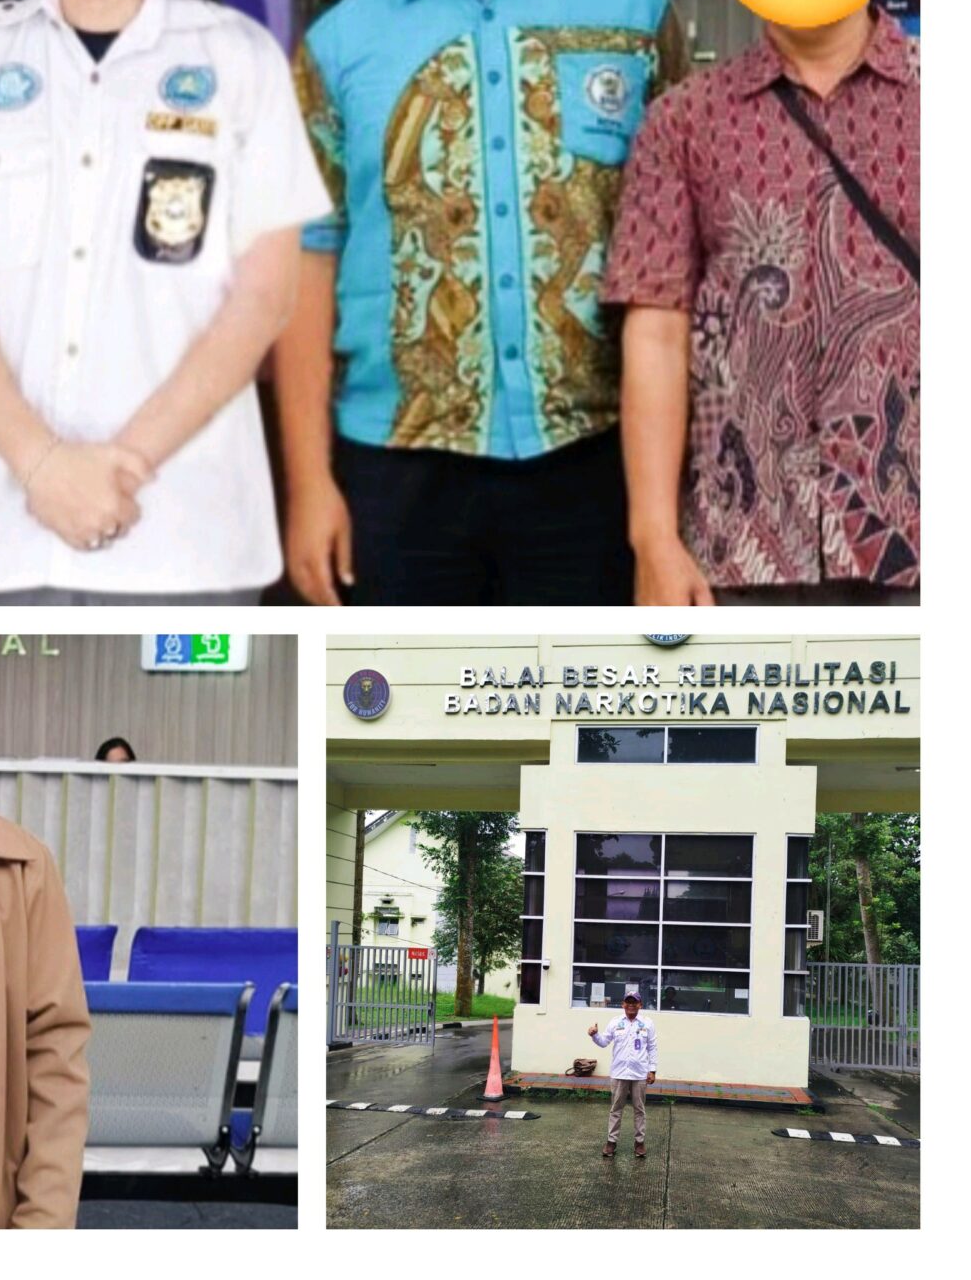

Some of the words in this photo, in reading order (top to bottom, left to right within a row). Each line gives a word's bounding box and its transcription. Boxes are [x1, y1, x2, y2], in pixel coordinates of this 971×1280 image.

[459, 665, 546, 688] BALAI
[562, 664, 661, 687] BESAR
[678, 660, 897, 688] REHABILITASI
[443, 692, 541, 715] BADAN
[555, 691, 730, 715] NARKOTIKA
[747, 689, 911, 715] NASIONAL
